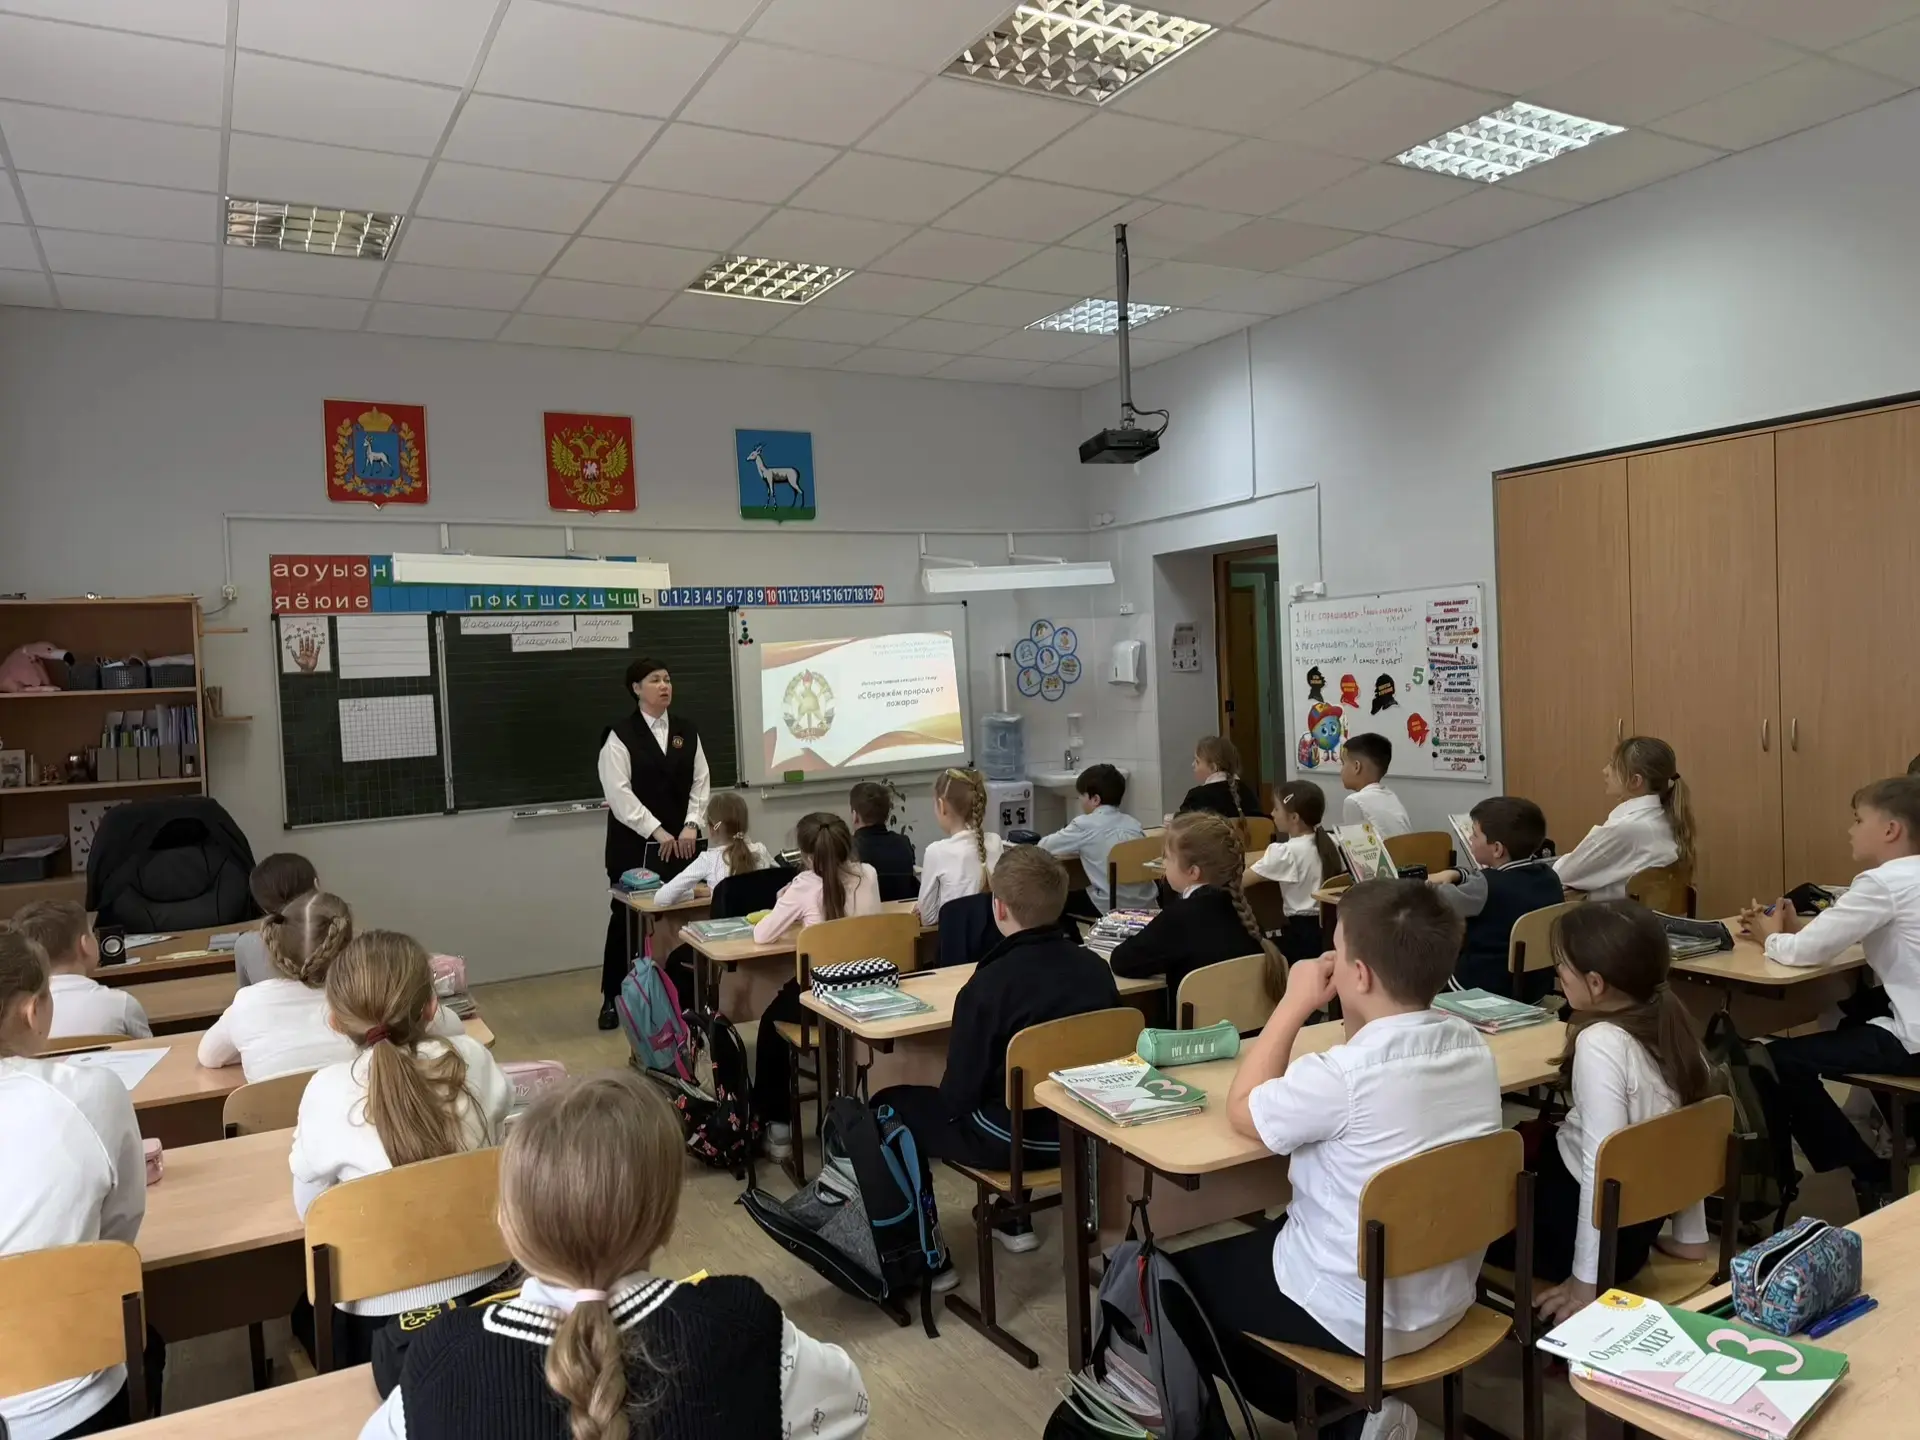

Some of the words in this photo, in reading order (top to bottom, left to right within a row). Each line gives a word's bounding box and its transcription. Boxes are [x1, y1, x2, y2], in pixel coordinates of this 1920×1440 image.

[583, 616, 622, 630] марта
[514, 635, 569, 646] Классная
[575, 633, 620, 646] работа
[1412, 666, 1424, 684] 5
[903, 687, 934, 696] природу
[1405, 683, 1411, 692] 5
[886, 698, 919, 708] пожара»
[1068, 1070, 1141, 1084] Окружающий
[1099, 1075, 1134, 1085] МИР
[1144, 1079, 1188, 1098] 3
[1589, 1314, 1662, 1360] Окружающий
[1630, 1328, 1675, 1356] МИР
[1706, 1329, 1804, 1374] 3
